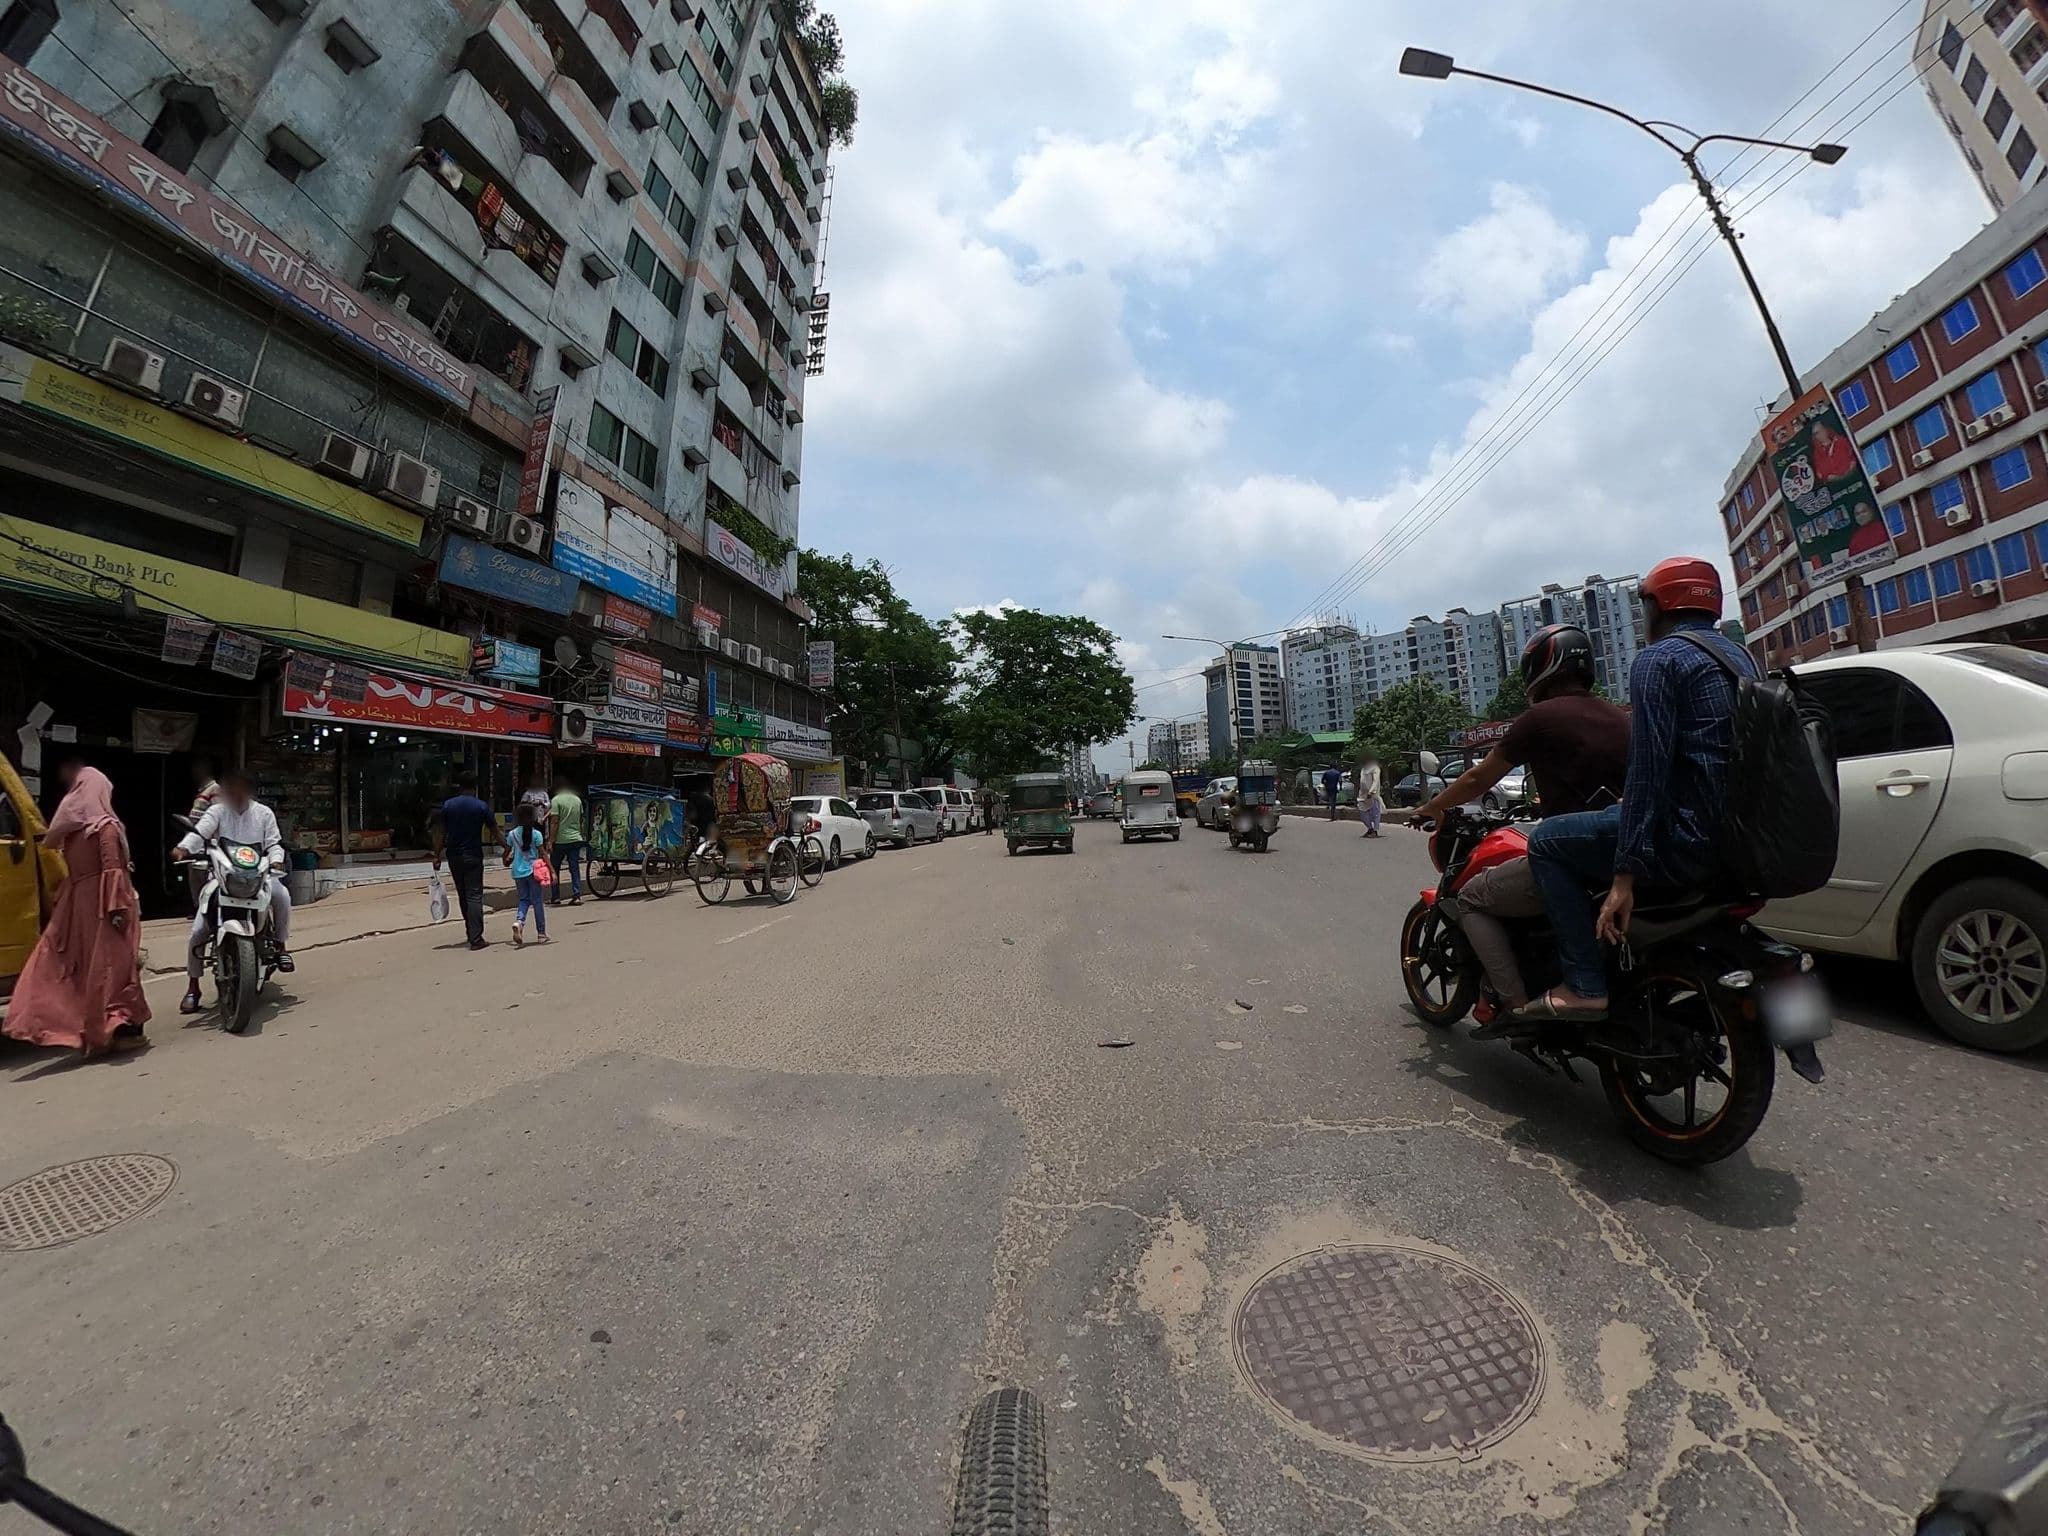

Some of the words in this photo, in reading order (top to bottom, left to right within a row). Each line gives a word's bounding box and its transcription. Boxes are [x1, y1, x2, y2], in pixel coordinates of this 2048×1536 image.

[3, 67, 113, 162] উত্তর
[126, 153, 196, 216] বঙ্গ
[211, 207, 359, 320] আবাসিক
[373, 318, 471, 393] হোটেল
[94, 553, 136, 579] Bank
[140, 567, 177, 588] PLC.
